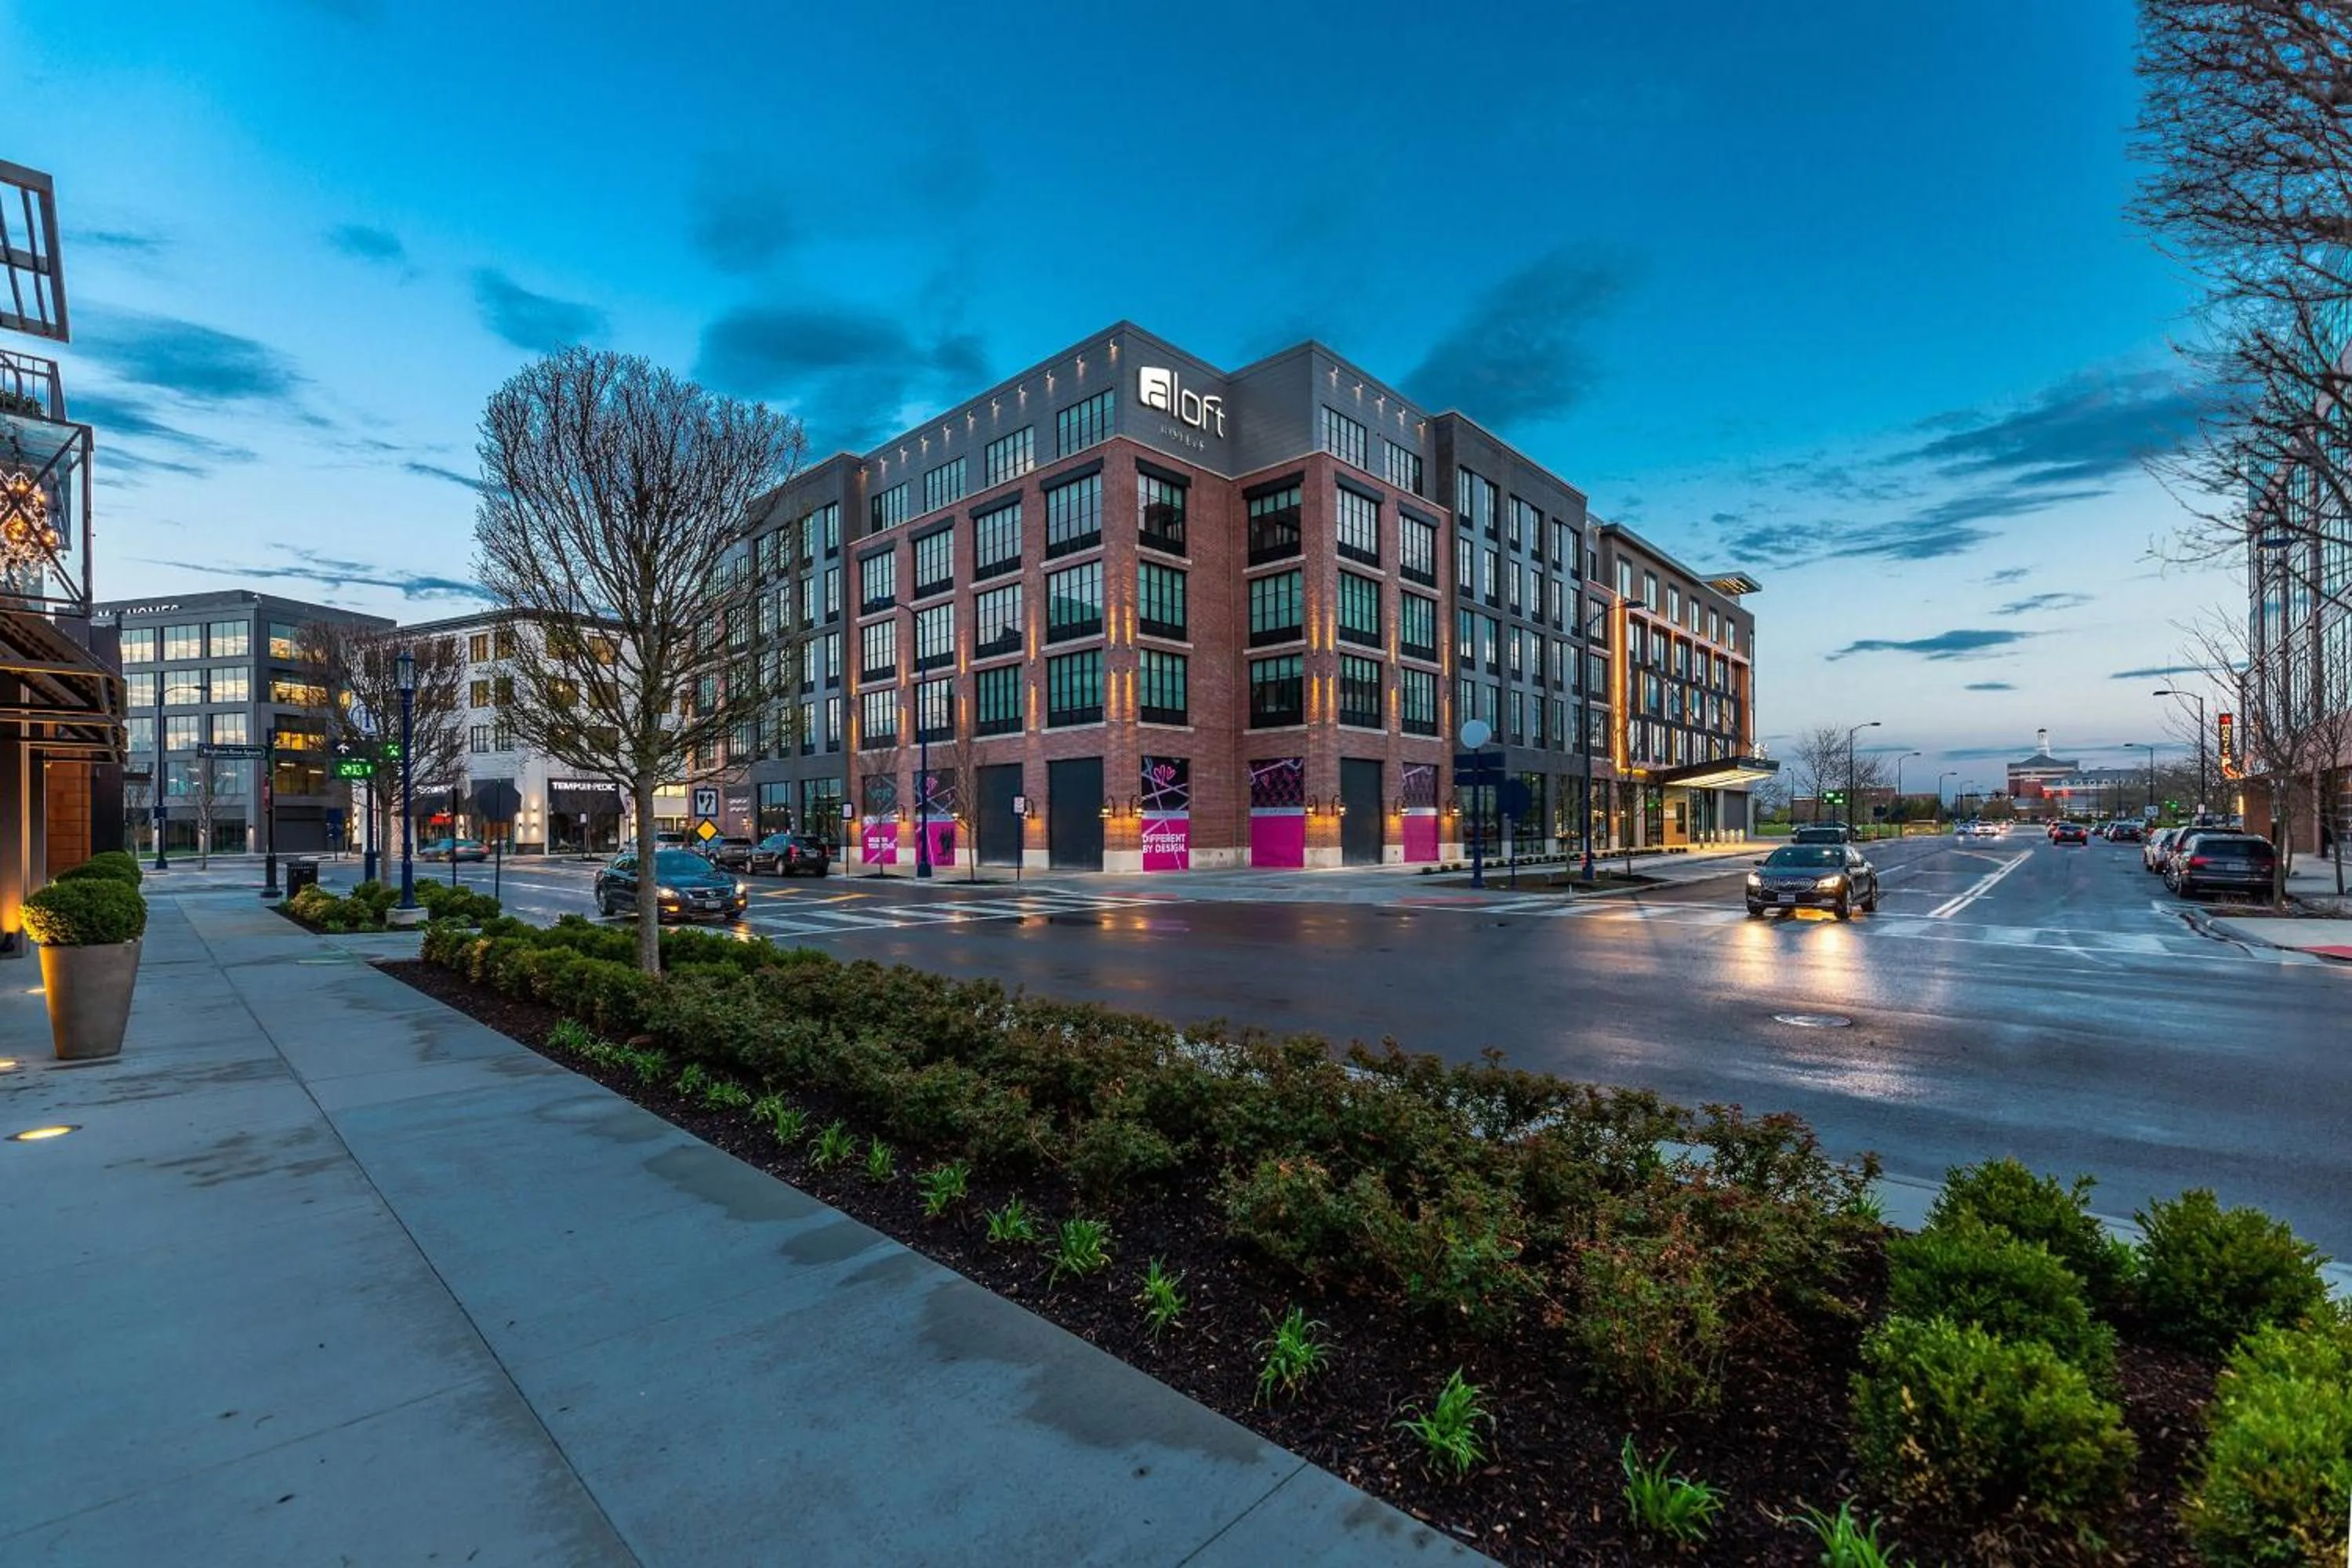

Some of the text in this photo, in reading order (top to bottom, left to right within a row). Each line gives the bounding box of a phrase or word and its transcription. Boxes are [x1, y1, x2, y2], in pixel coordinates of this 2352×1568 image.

[1140, 366, 1225, 438] aloft
[1142, 833, 1186, 843] DIFFERENT
[1142, 844, 1153, 854] BY
